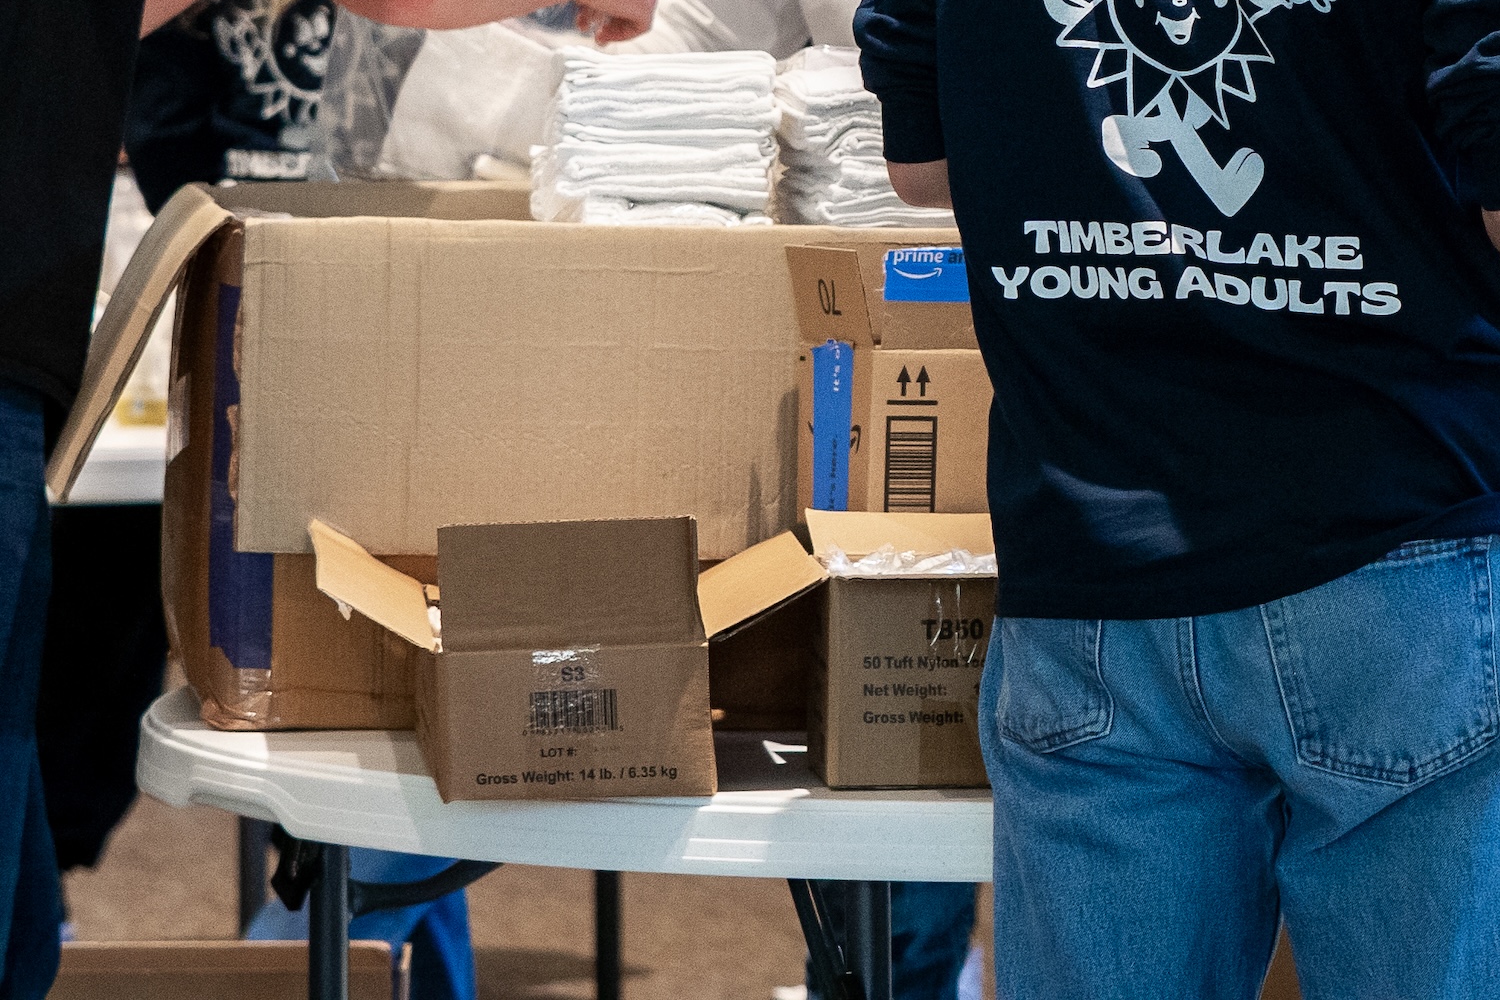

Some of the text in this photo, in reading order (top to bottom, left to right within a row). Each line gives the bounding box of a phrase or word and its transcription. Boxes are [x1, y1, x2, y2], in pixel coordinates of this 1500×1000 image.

[1023, 220, 1363, 270] TIMBERLAKE
[892, 251, 944, 265] prime
[991, 265, 1402, 316] YOUNG ADULTS
[921, 619, 983, 640] TB50
[863, 656, 881, 669] 50
[885, 655, 913, 669] Tuft
[917, 656, 959, 671] Nylon
[561, 666, 585, 682] S3
[863, 684, 889, 696] Net
[892, 684, 947, 699] Weight:
[863, 711, 964, 726] Gross Weight:
[540, 748, 564, 757] LOT
[476, 773, 518, 785] Gross
[522, 770, 574, 784] Weight:
[579, 769, 595, 780] 14
[600, 768, 616, 779] lb.
[628, 767, 656, 778] 6.35
[661, 766, 678, 779] kg
